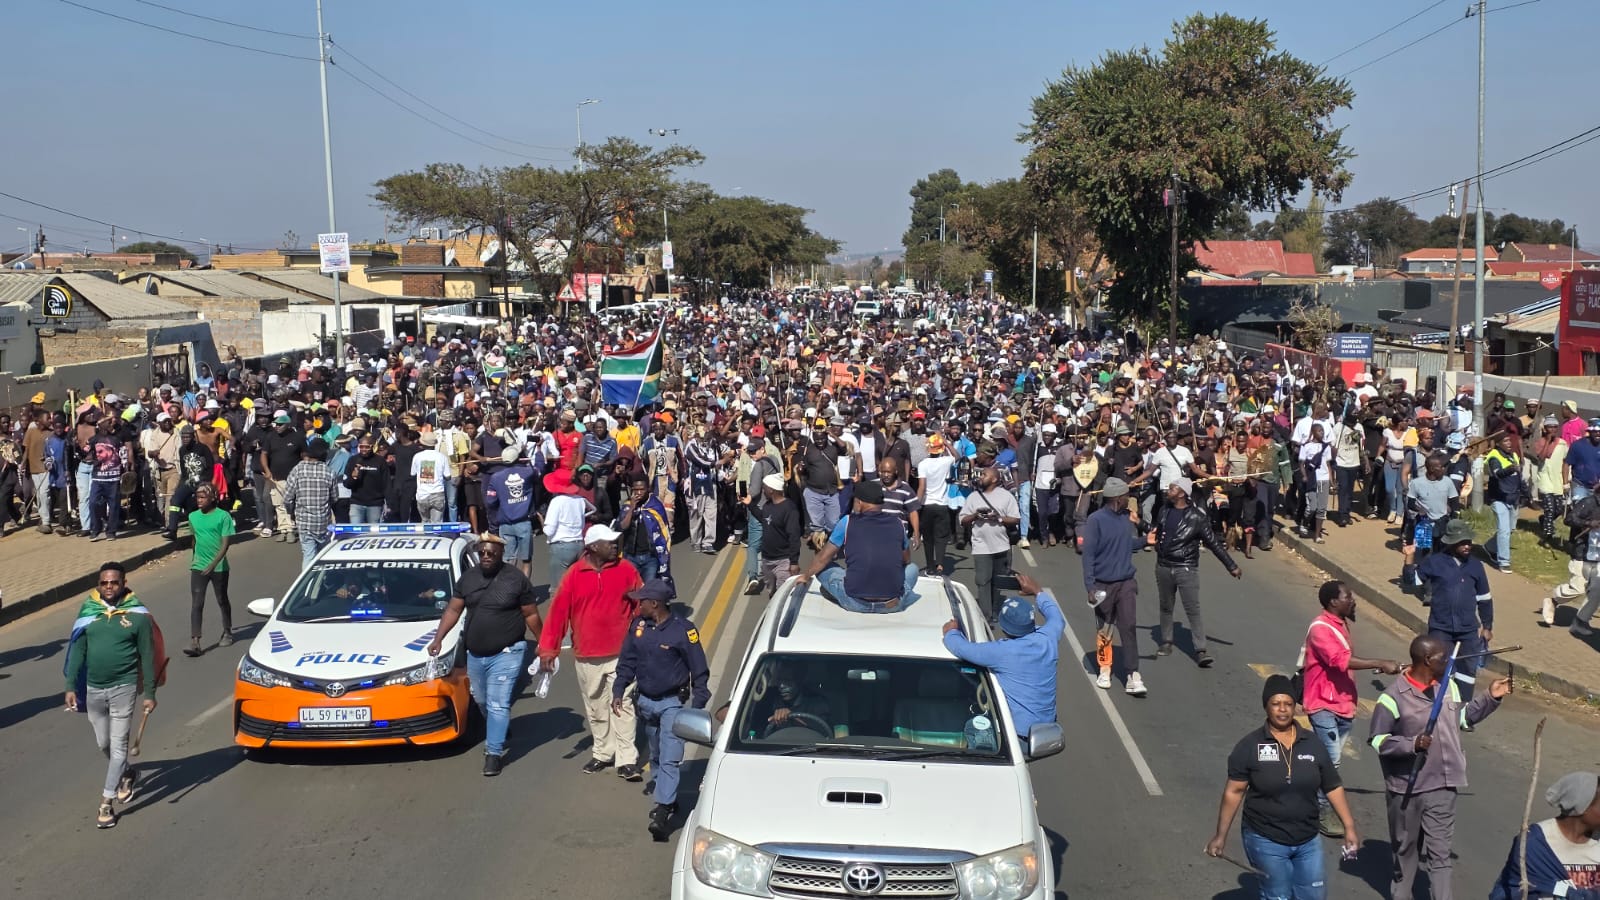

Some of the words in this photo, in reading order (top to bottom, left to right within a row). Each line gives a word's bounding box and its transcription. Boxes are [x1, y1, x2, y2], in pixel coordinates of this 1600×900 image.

[295, 653, 391, 667] POLICE
[302, 710, 315, 721] LL
[319, 710, 331, 721] 59
[355, 709, 367, 719] GP
